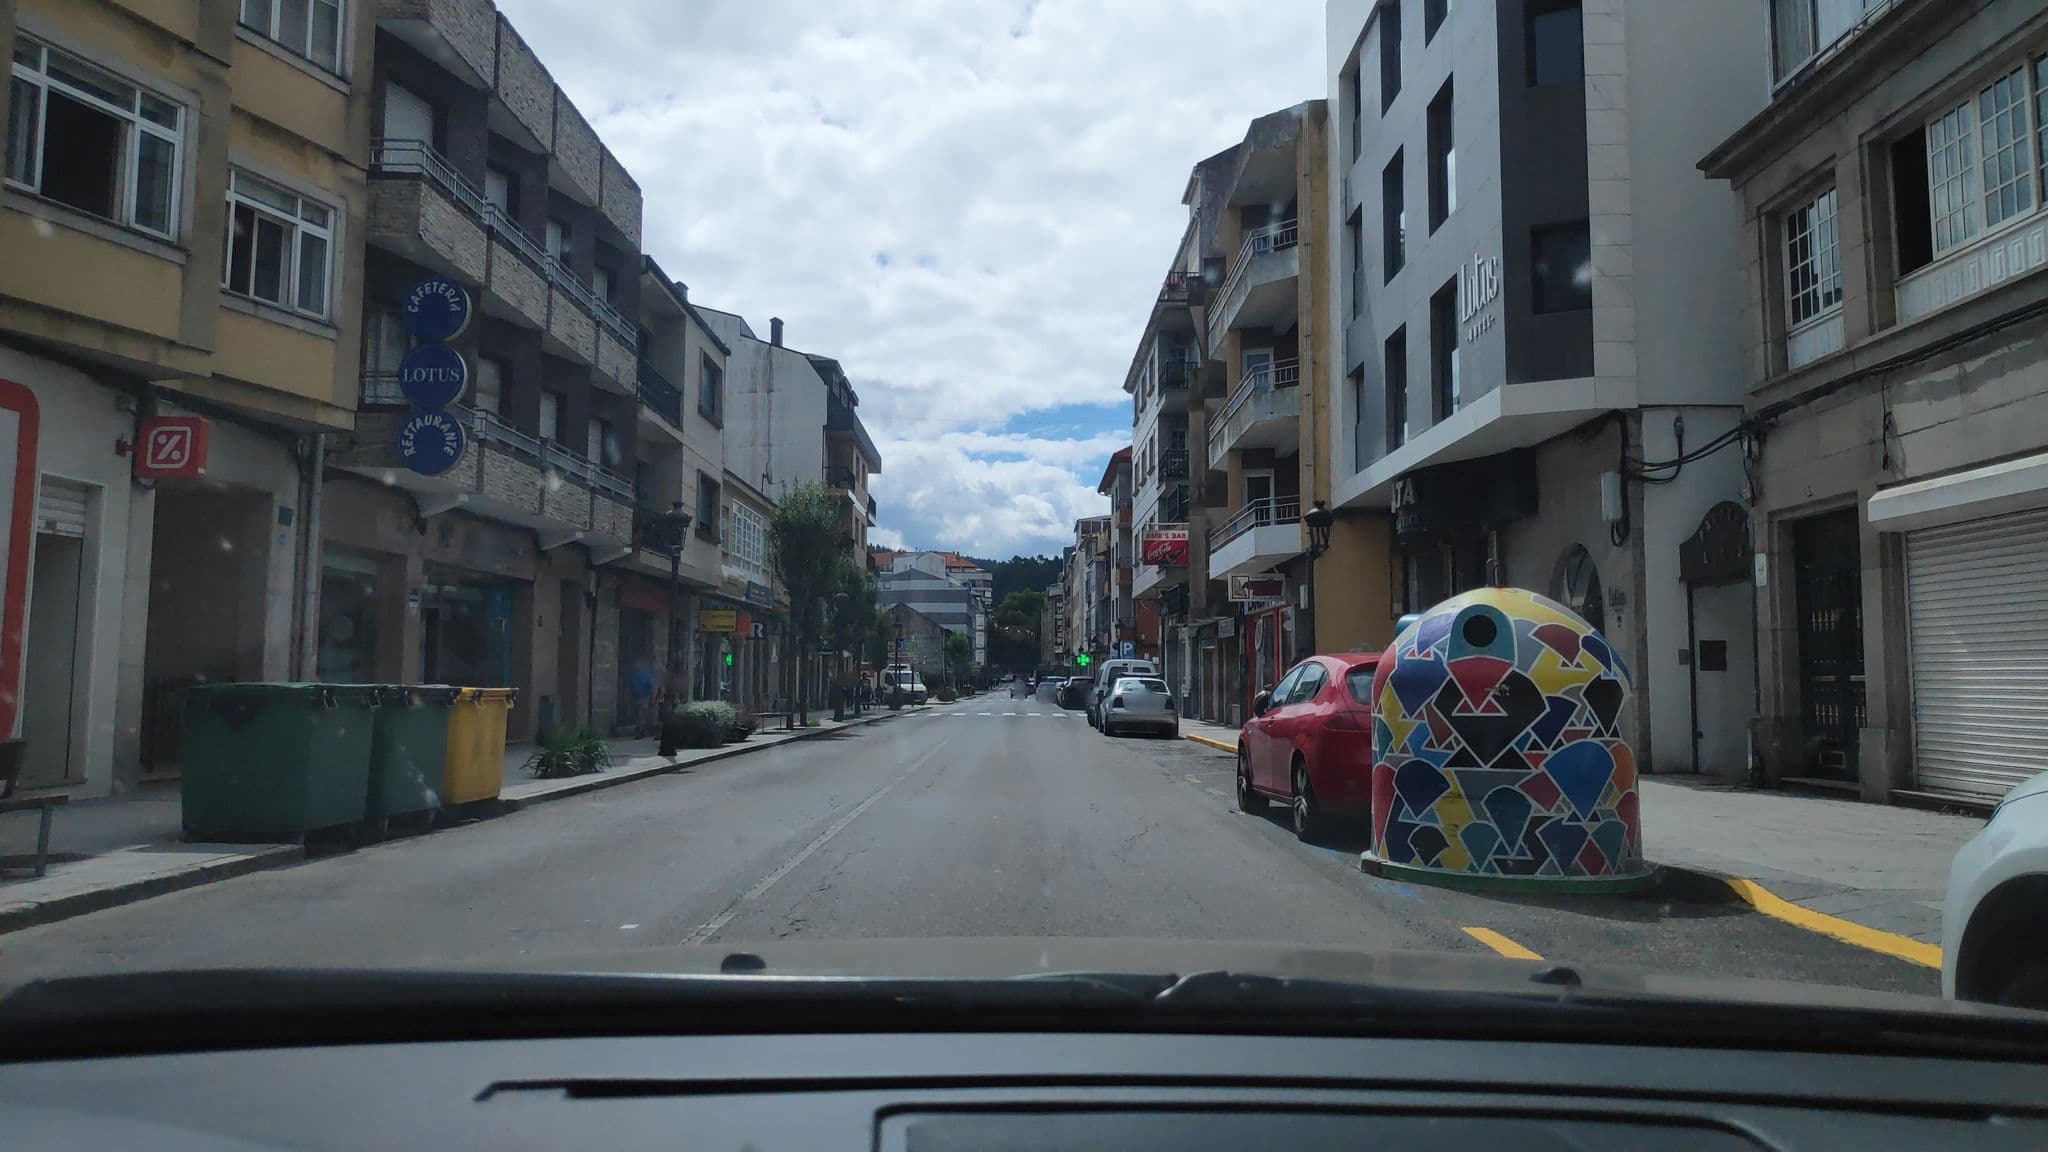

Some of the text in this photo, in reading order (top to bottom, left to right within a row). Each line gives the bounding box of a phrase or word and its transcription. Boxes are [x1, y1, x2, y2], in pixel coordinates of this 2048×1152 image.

[1460, 253, 1498, 322] Lotus
[408, 281, 461, 312] CAFETERIA
[403, 367, 461, 384] LOTUS
[402, 414, 457, 457] RESTAURANTE
[1172, 532, 1186, 540] BAR
[752, 622, 764, 639] R
[1124, 642, 1133, 654] P
